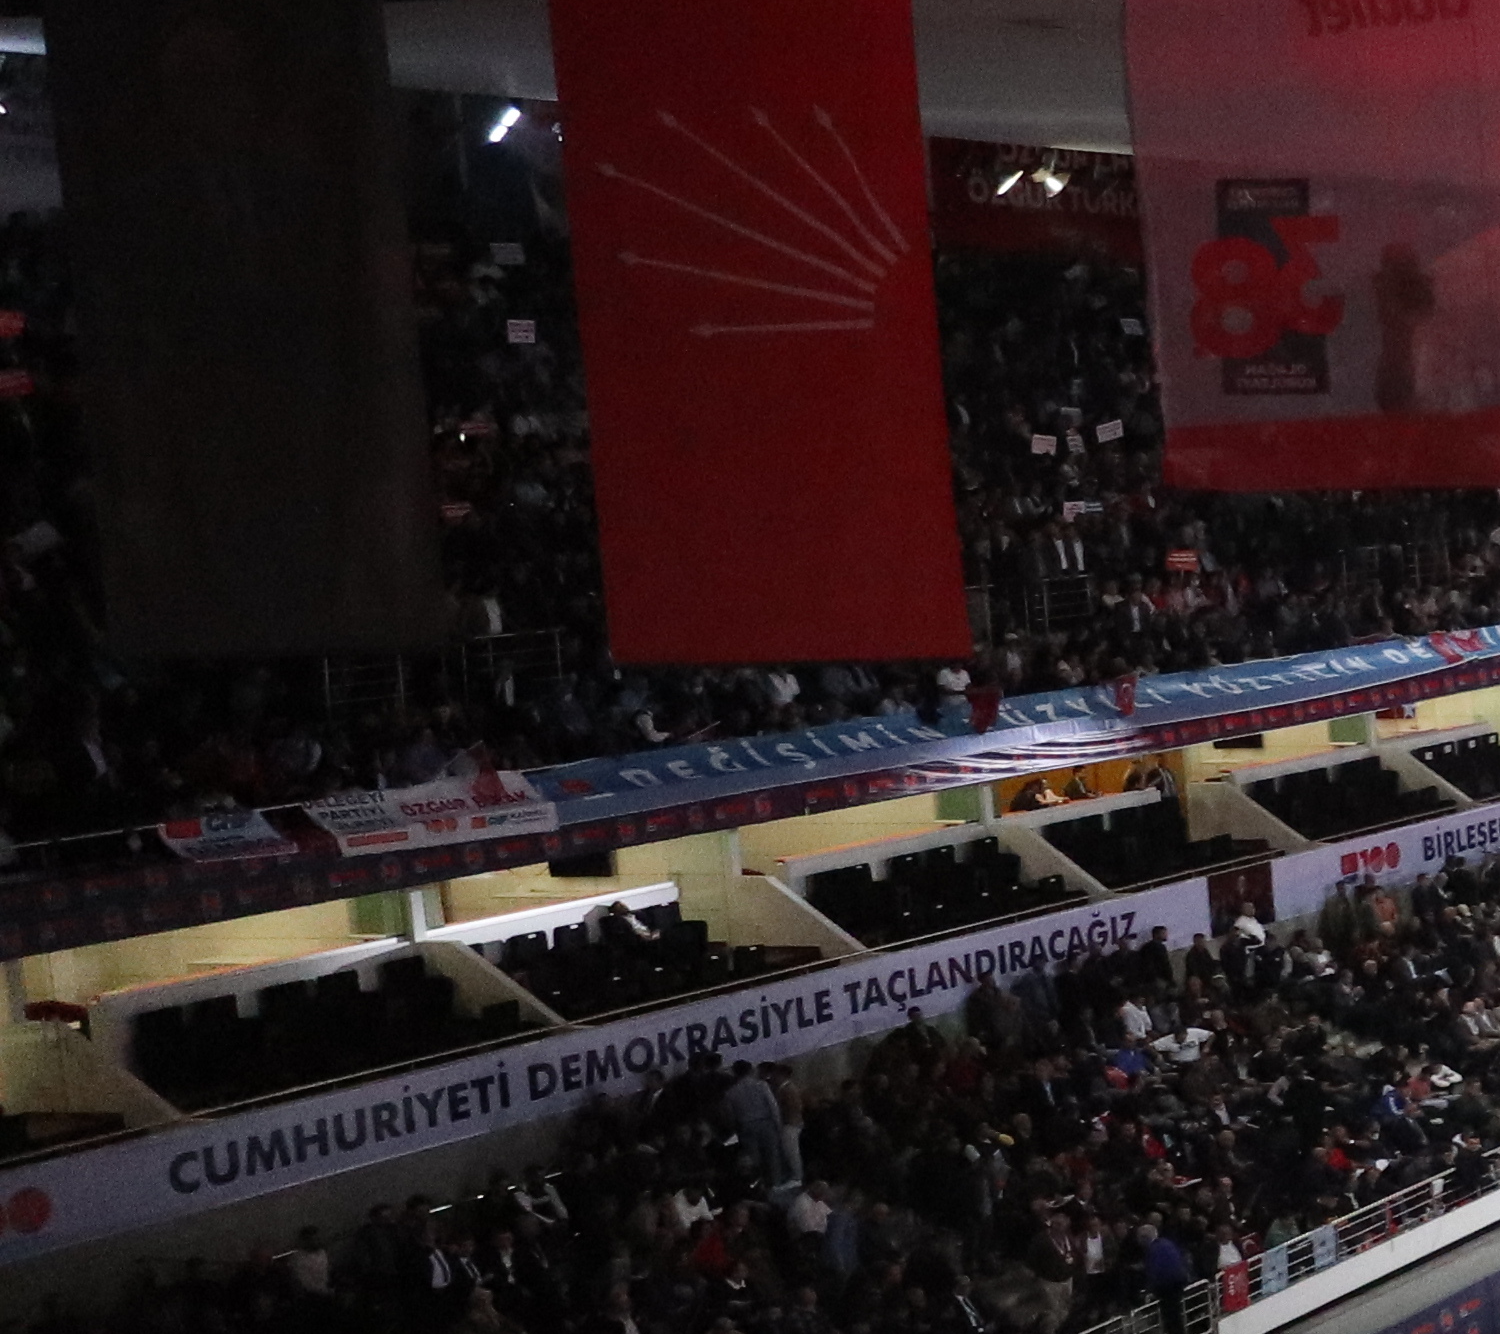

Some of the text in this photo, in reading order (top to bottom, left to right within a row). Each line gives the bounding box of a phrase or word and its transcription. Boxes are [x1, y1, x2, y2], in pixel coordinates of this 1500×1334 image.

[167, 910, 1138, 1195] CUMHURİYETİ DEMOKRASİYLE TAÇLANDIRACAĞIZ
